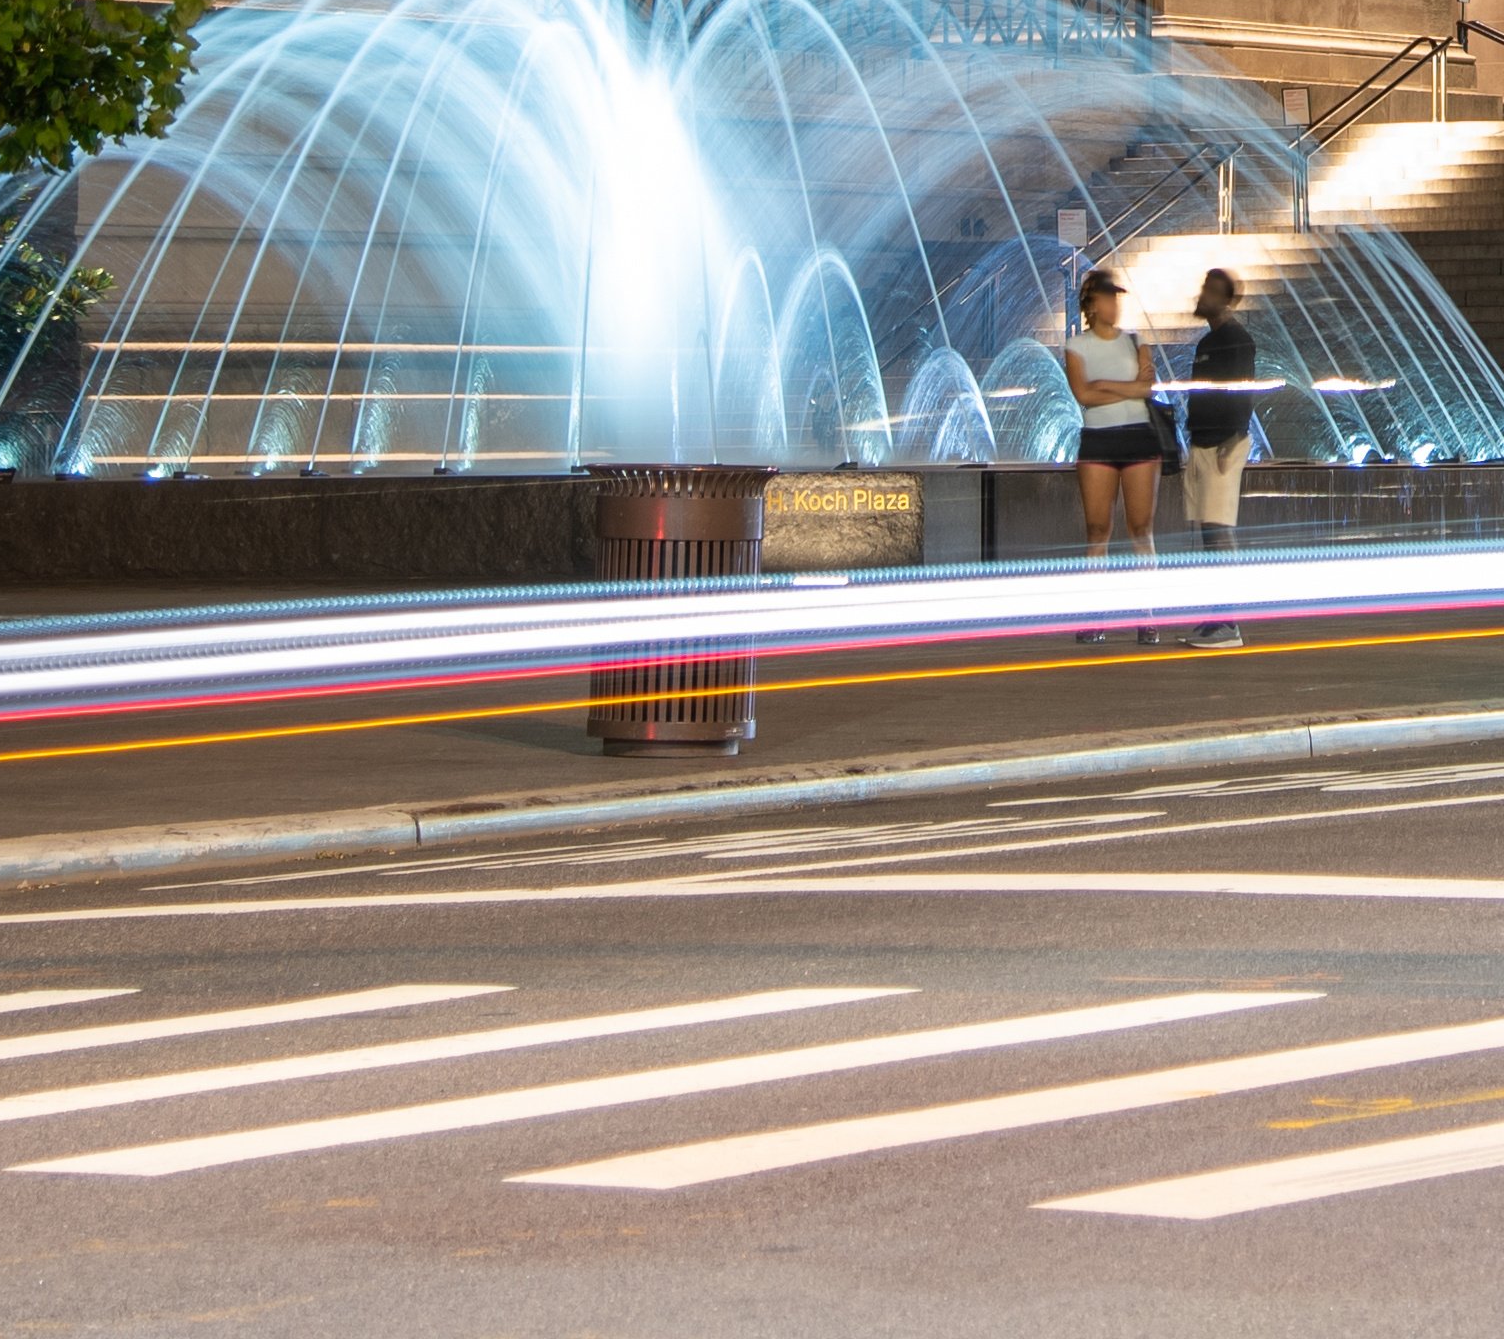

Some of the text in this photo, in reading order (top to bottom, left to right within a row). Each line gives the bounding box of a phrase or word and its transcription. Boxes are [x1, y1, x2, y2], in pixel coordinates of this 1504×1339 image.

[766, 489, 910, 512] H. Koch Plaza
